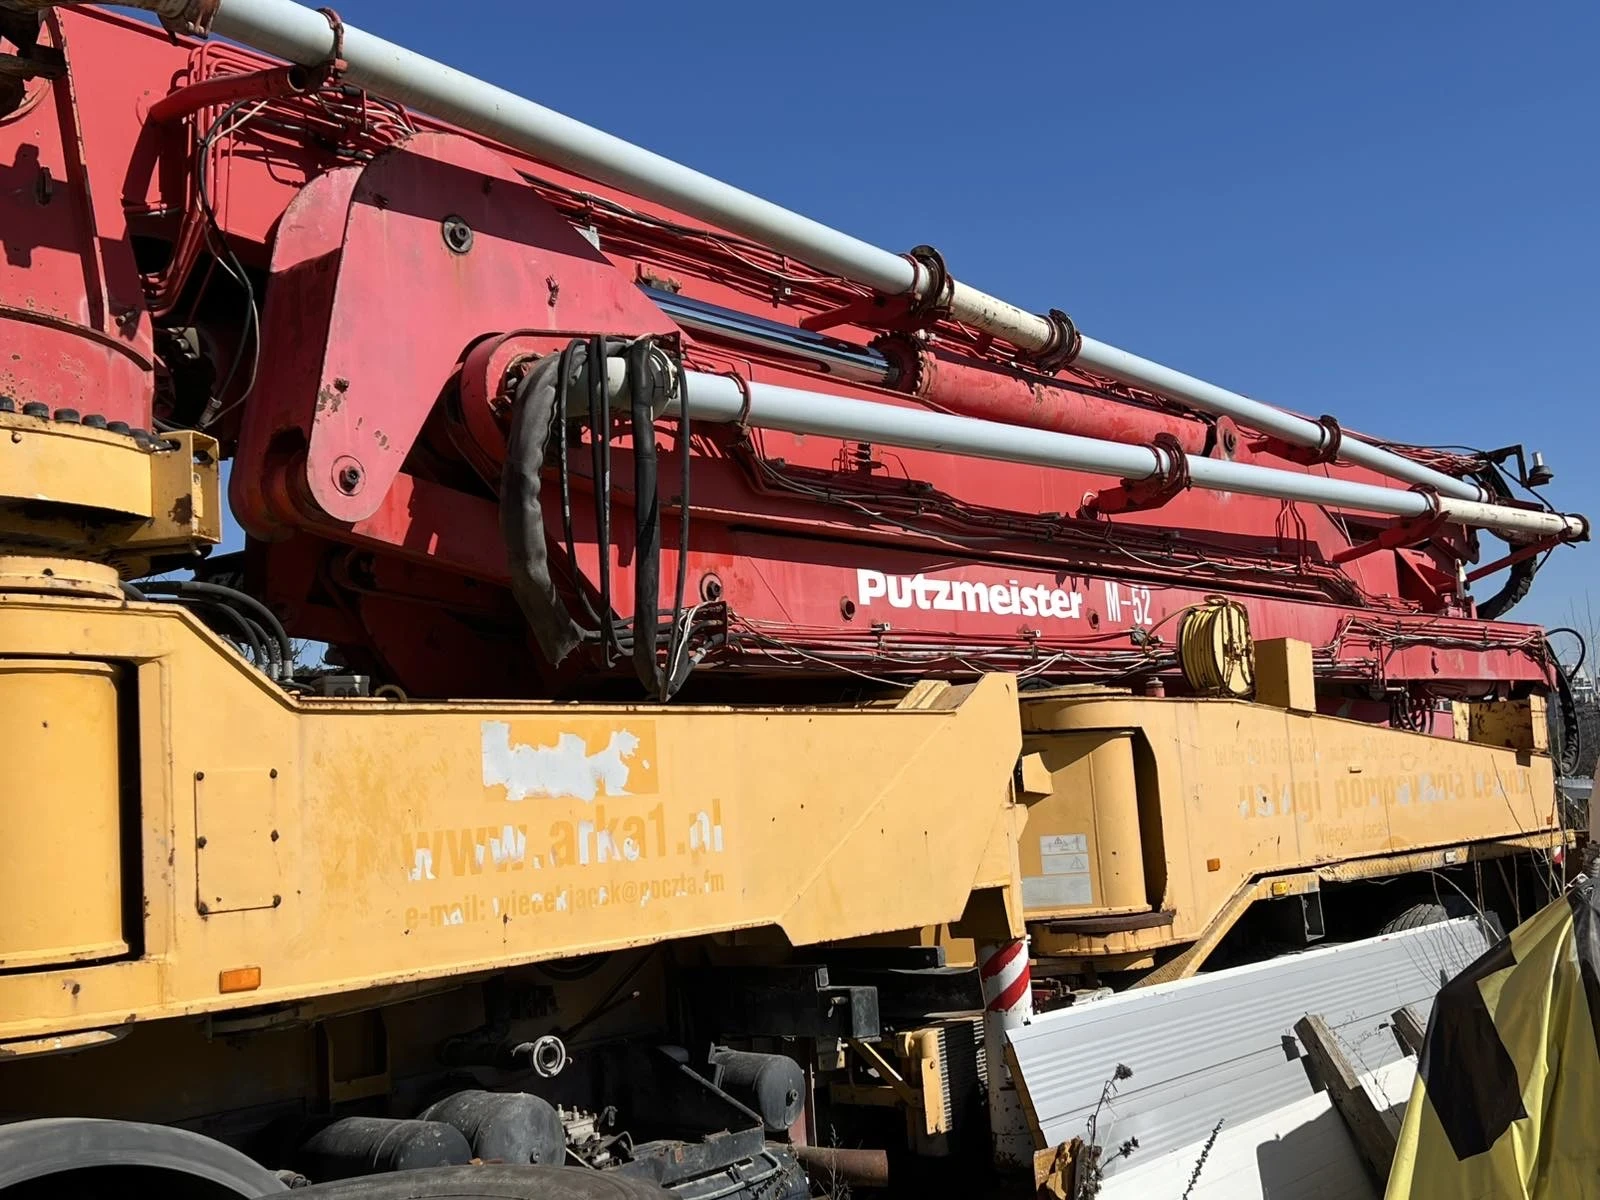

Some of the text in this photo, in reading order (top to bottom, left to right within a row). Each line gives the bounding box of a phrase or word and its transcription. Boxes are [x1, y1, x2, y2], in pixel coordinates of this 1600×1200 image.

[857, 568, 1082, 619] Putzmeister
[1105, 580, 1153, 625] M-52
[401, 798, 725, 881] www.arka1.pl
[405, 895, 486, 930] e-mail:
